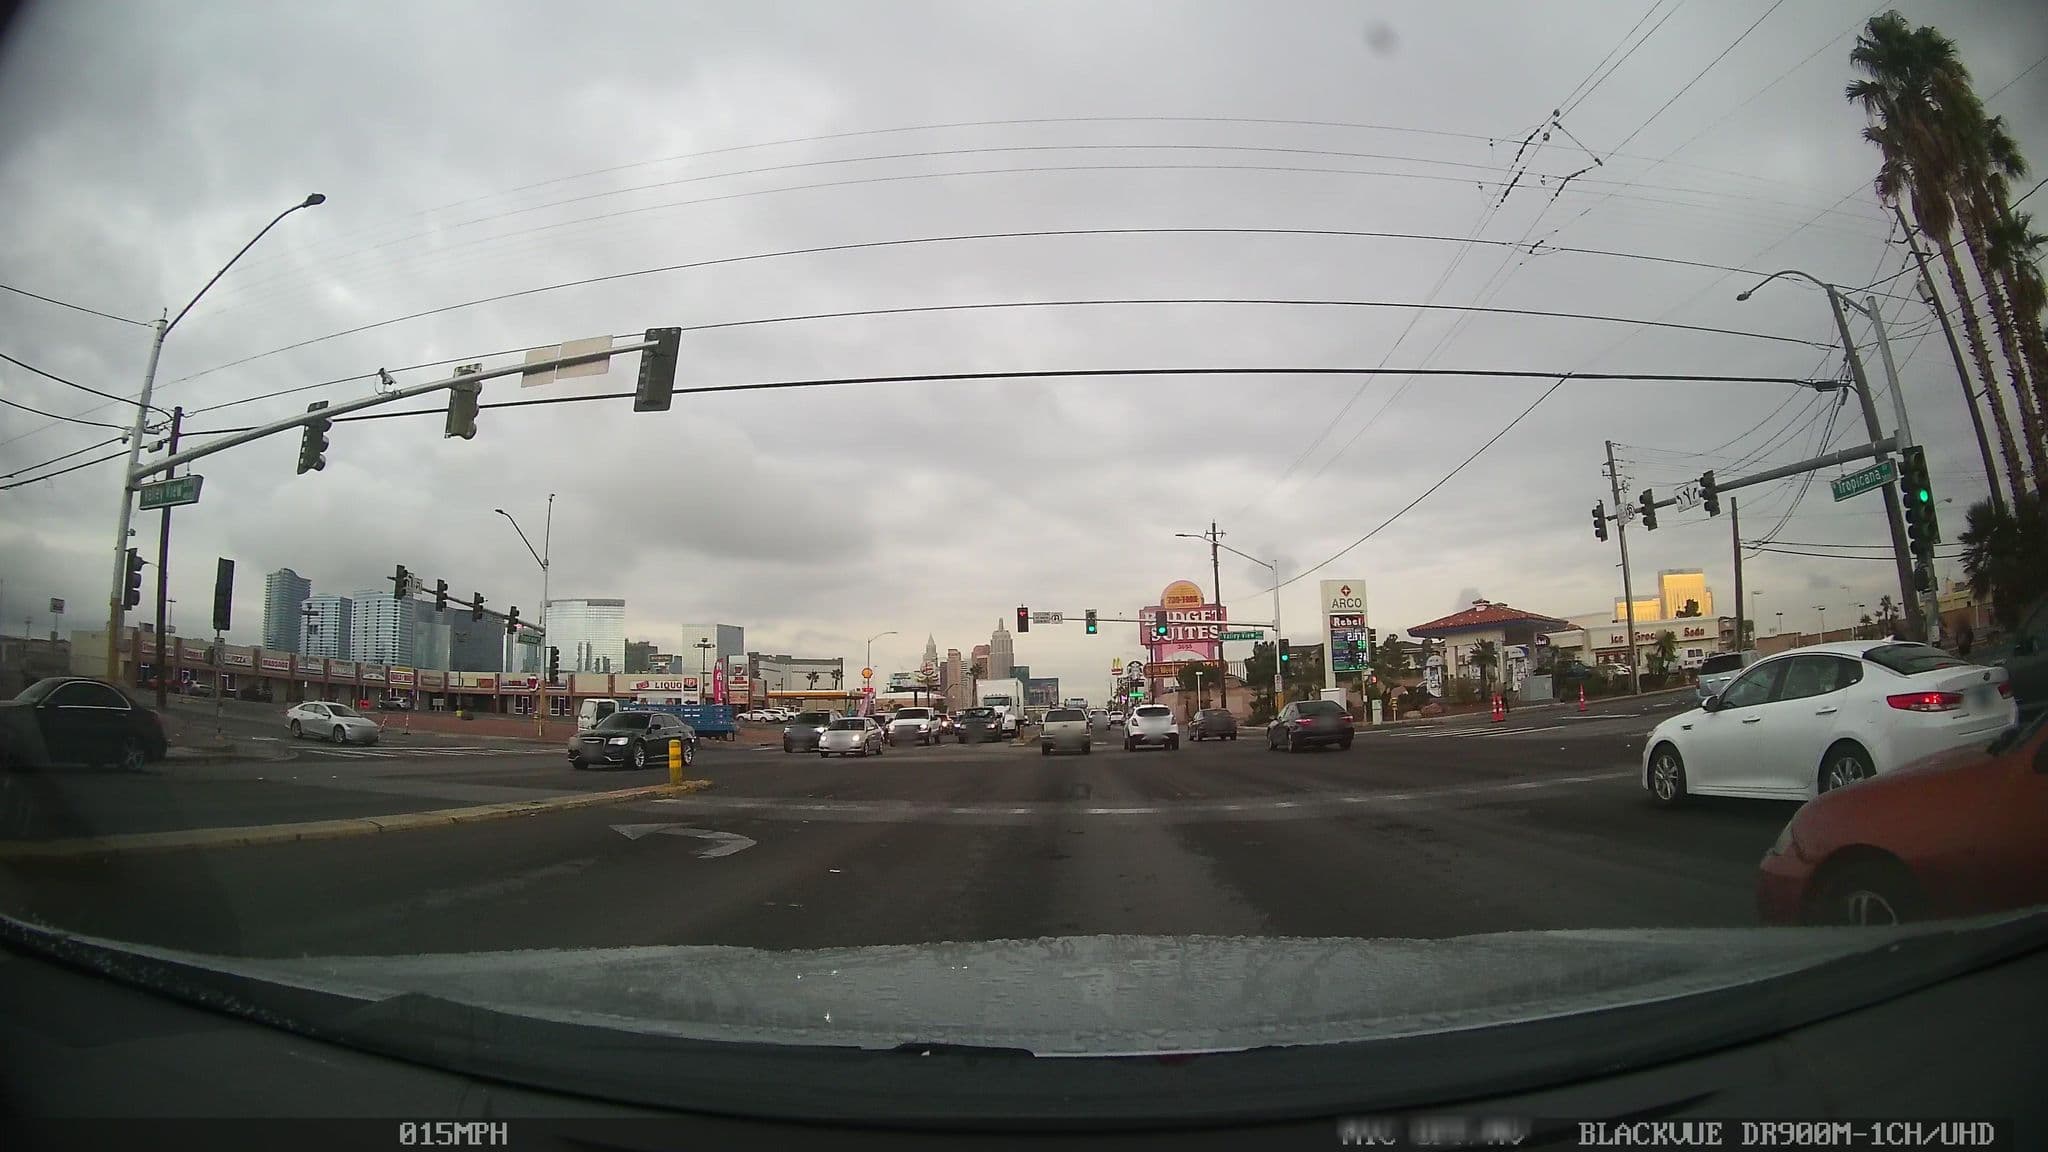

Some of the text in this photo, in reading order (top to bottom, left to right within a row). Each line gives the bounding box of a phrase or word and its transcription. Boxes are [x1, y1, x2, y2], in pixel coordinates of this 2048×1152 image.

[1838, 469, 1881, 495] Tropicana
[1332, 598, 1362, 609] ARCO
[1333, 616, 1363, 626] Rebel
[1610, 633, 1624, 644] Ice
[1684, 627, 1705, 637] Soda
